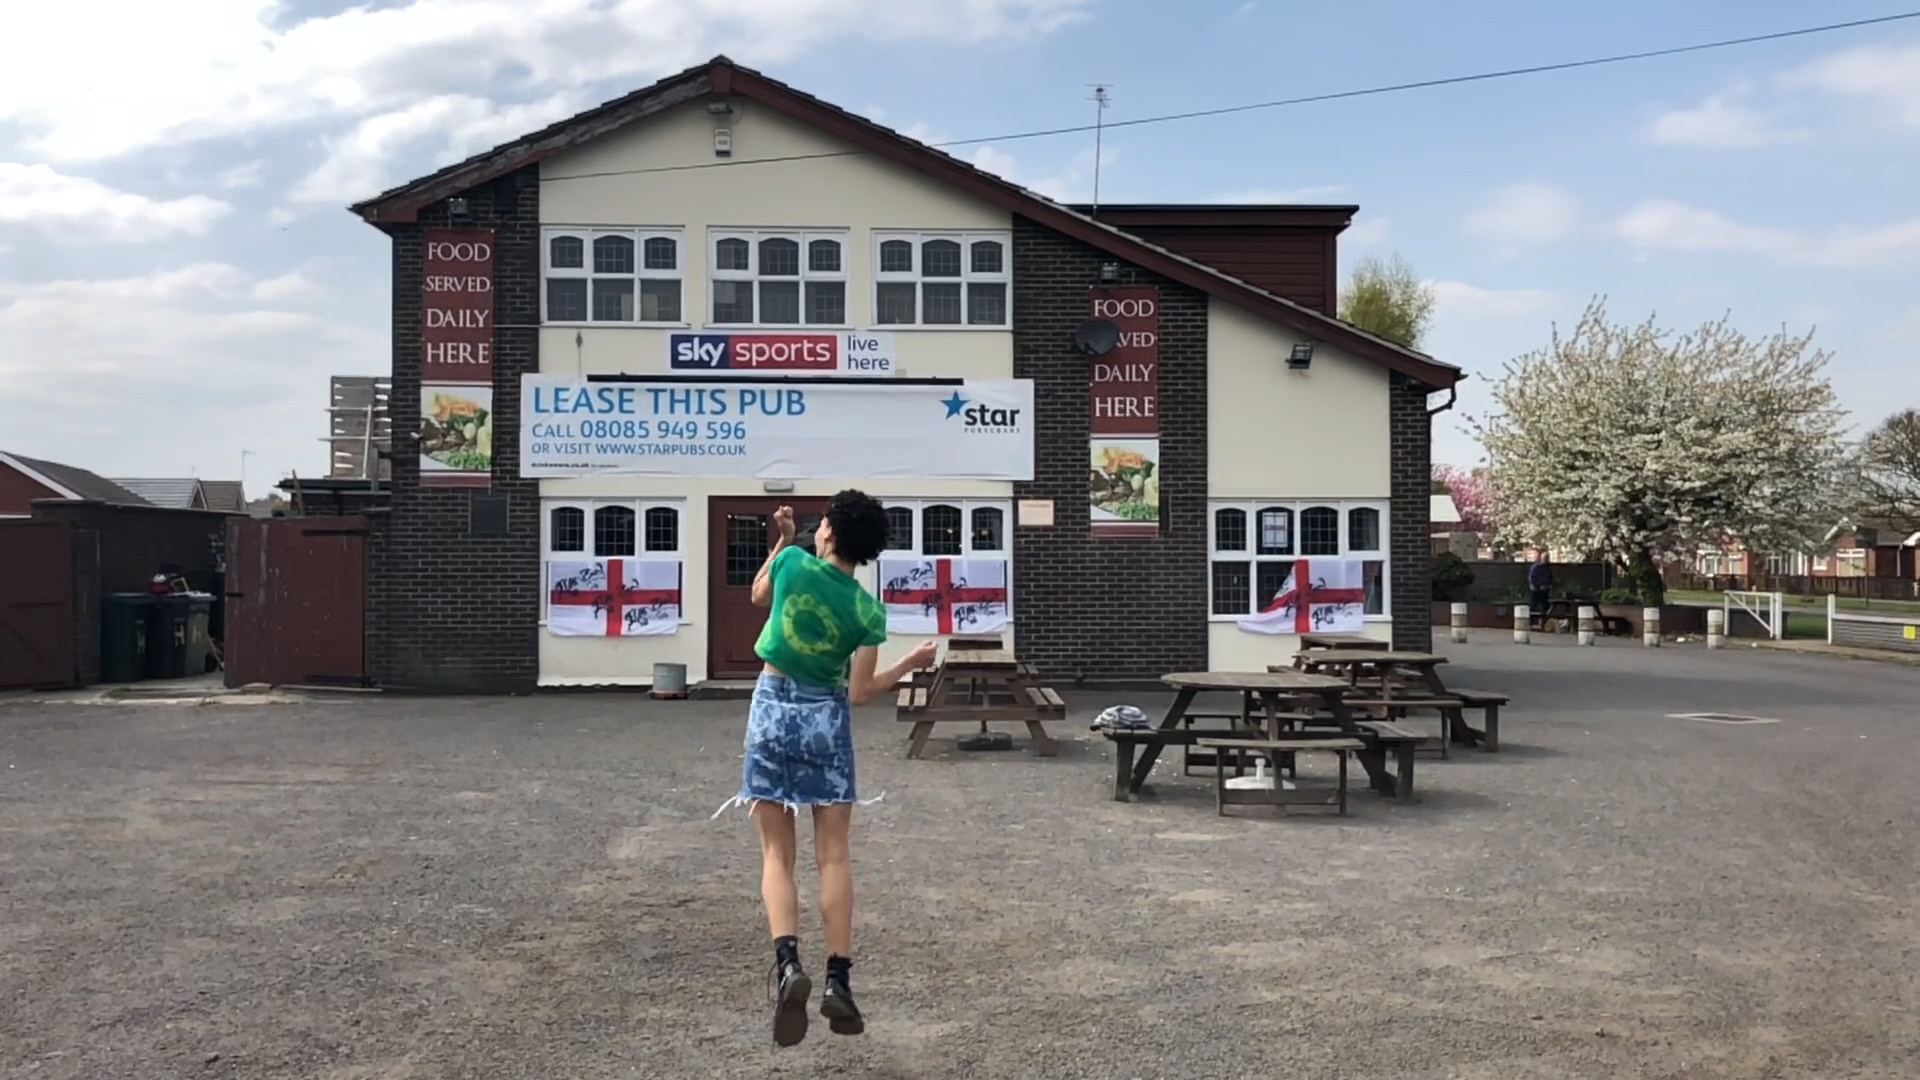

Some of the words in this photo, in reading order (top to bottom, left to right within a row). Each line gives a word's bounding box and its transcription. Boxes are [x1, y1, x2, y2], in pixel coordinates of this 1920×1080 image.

[427, 241, 491, 262] FOOD
[425, 275, 491, 293] SERVED
[425, 308, 489, 328] DAILY
[1093, 299, 1155, 318] FOOD
[426, 342, 490, 364] HERE
[676, 336, 726, 367] sky
[735, 339, 831, 367] sports
[847, 335, 879, 351] live
[847, 354, 890, 370] here
[1094, 363, 1154, 383] DAILY
[533, 386, 636, 414] LEASE
[645, 387, 728, 415] THIS
[739, 388, 806, 416] PUB
[1094, 396, 1155, 417] HERE
[964, 403, 1020, 427] star
[531, 422, 575, 438] CALL
[580, 419, 650, 439] 08085
[657, 420, 698, 440] 949
[706, 421, 746, 440] 596
[531, 442, 550, 454] OR
[554, 442, 591, 455] VISIT
[595, 443, 746, 456] WWW.STARPUBS.CO.UK
